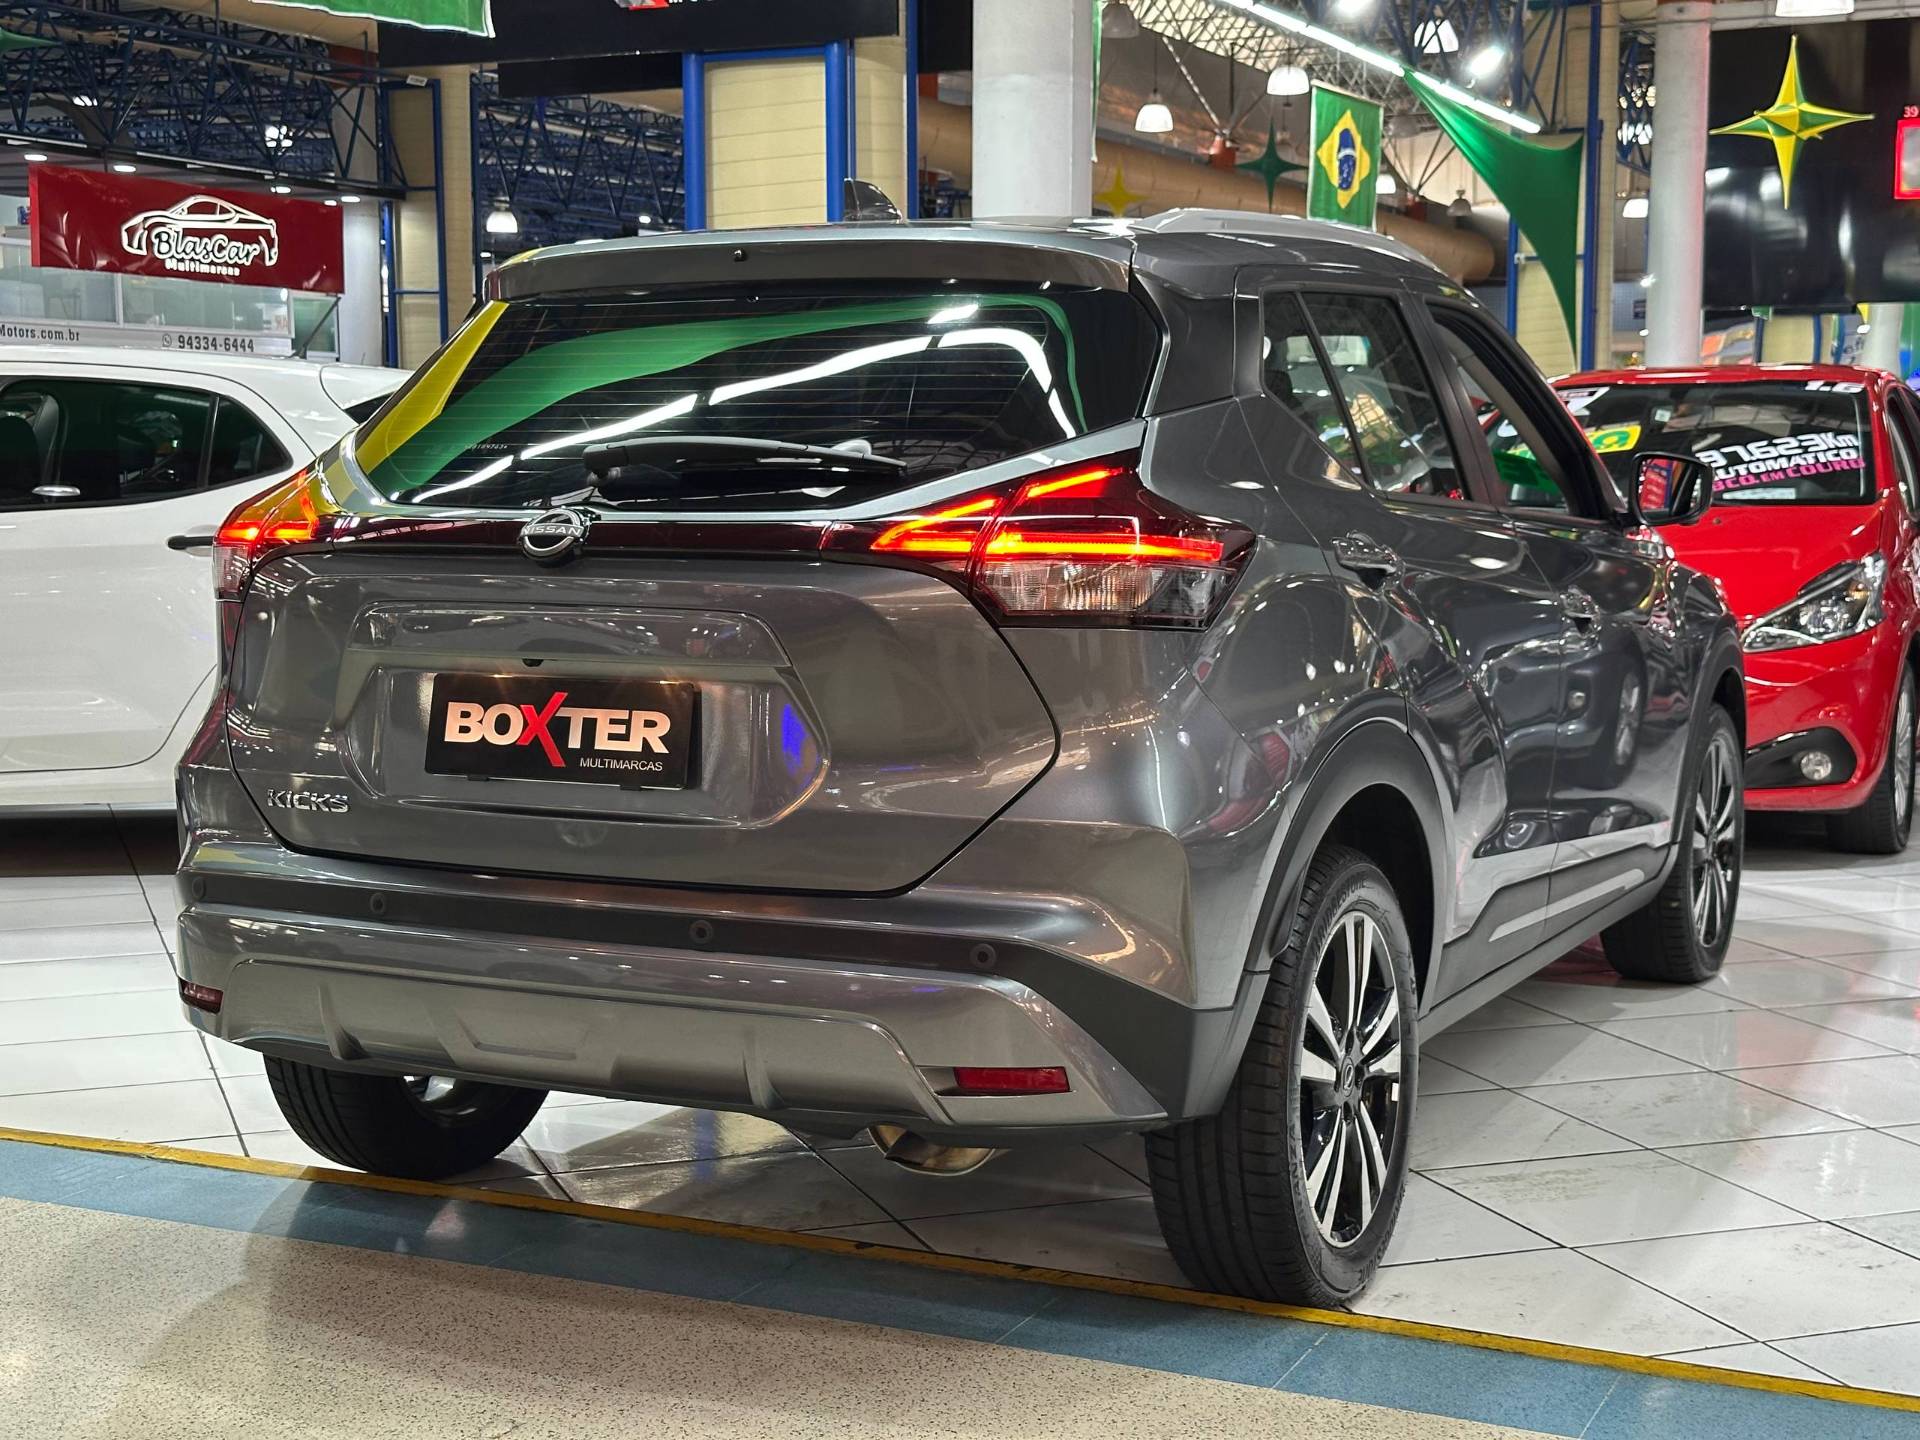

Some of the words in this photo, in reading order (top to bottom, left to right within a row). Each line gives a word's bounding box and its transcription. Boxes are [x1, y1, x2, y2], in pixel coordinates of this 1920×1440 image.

[152, 226, 261, 266] BlasCar
[164, 258, 241, 277] Multimarcas
[178, 333, 255, 353] 94334-6444
[1804, 380, 1865, 394] 1.6
[1714, 448, 1859, 481] UTOMATICO
[1787, 457, 1867, 478] COURO
[522, 525, 582, 537] NISSAN
[443, 691, 672, 768] BOXTER
[579, 757, 664, 772] MULTIMARCAS
[267, 788, 350, 814] KICKS
